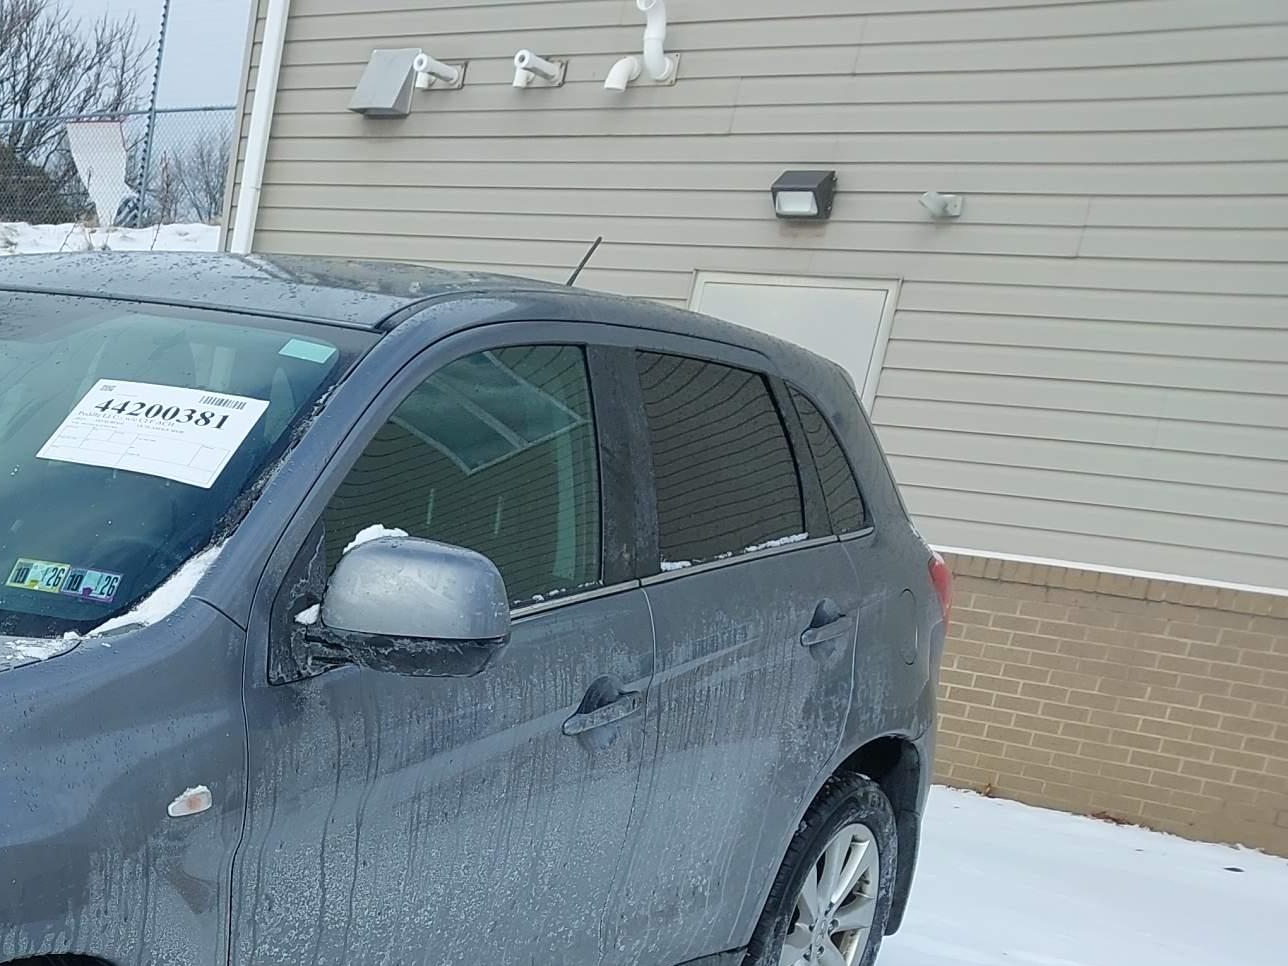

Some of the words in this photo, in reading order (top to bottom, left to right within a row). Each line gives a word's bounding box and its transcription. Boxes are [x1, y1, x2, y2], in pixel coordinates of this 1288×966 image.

[94, 398, 230, 430] 44200381
[13, 567, 30, 584] 10
[46, 567, 65, 587] 26
[65, 573, 84, 592] 10
[99, 576, 118, 597] 26
